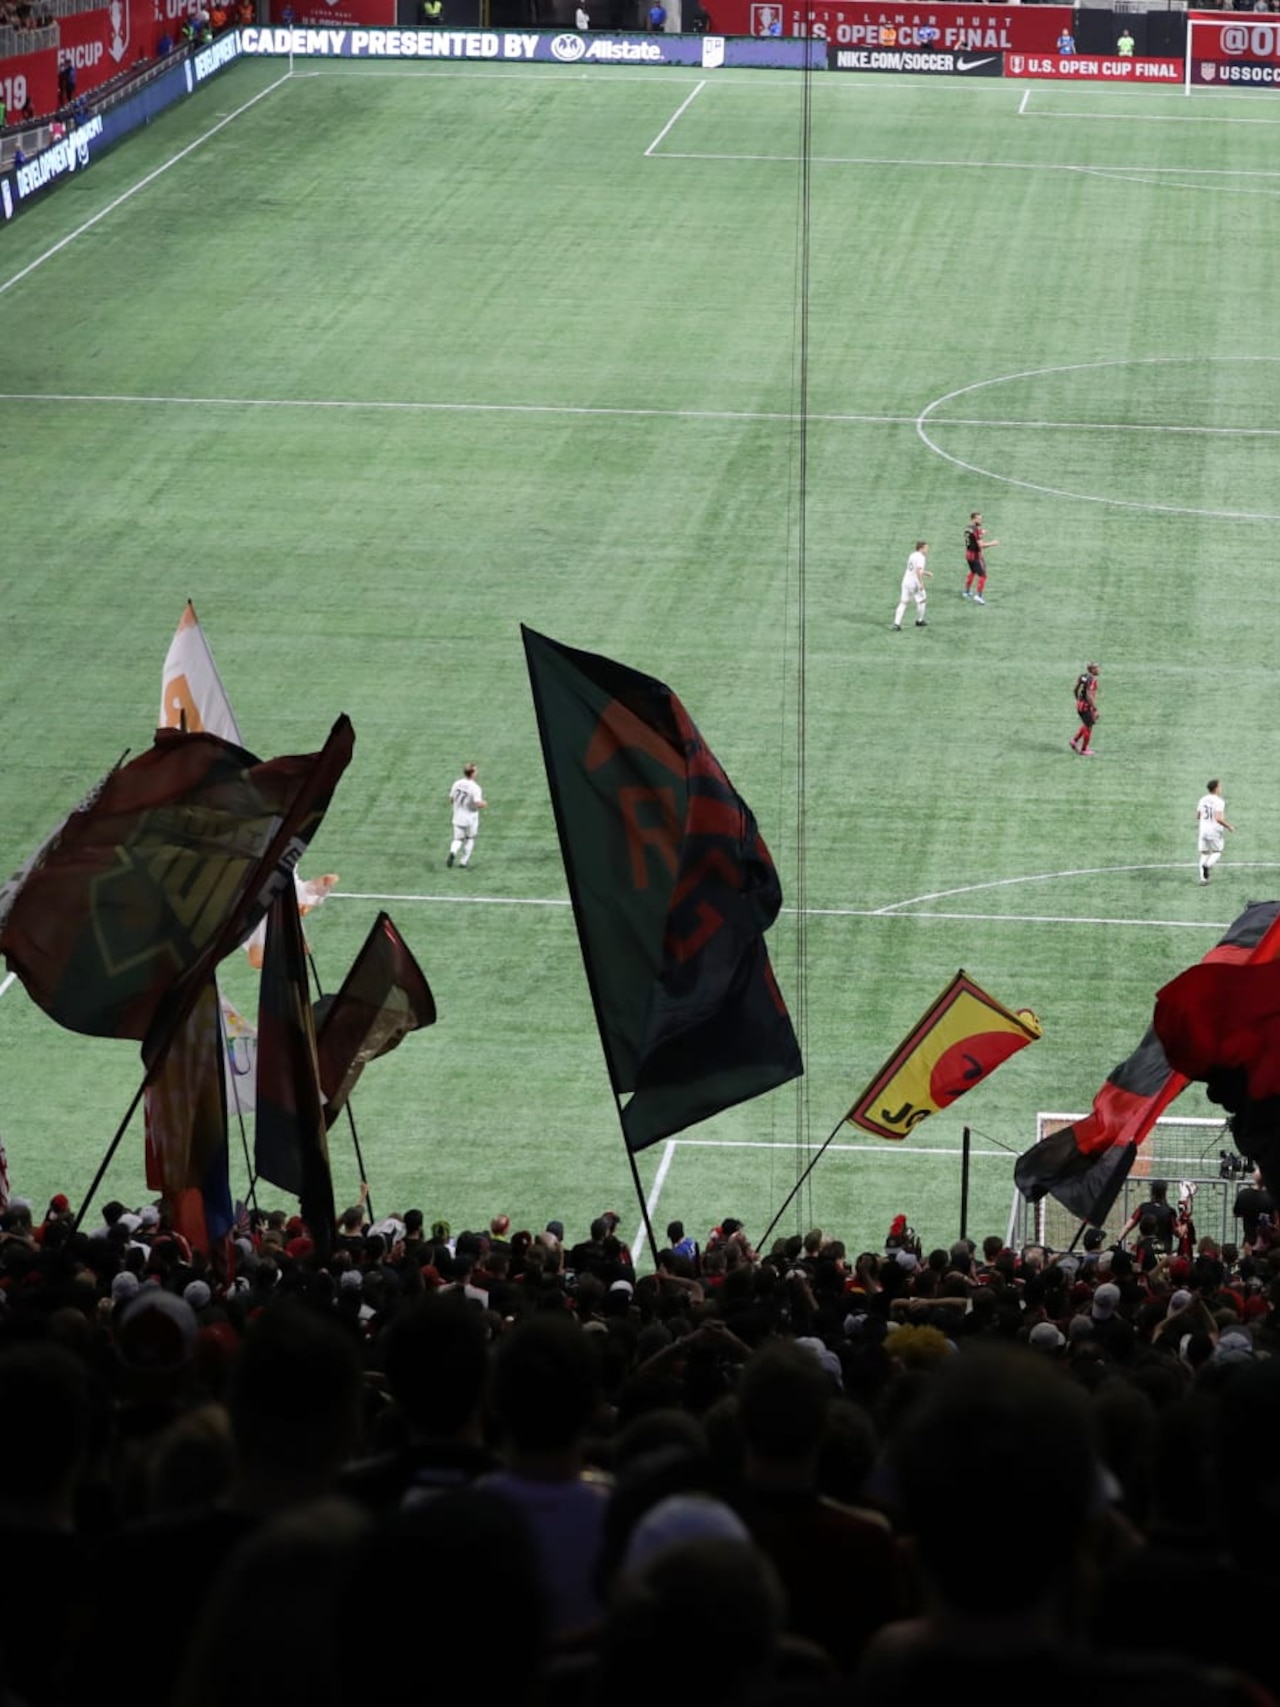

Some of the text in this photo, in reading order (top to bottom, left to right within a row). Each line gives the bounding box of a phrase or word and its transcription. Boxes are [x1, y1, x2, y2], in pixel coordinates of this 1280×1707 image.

[864, 14, 936, 25] LAMAR
[957, 17, 1012, 27] HUNT
[352, 31, 499, 58] PRESENTED
[504, 35, 539, 58] BY
[945, 28, 1012, 48] FINAL
[837, 51, 954, 71] NIKE.COM/SOCCER
[1028, 58, 1178, 78] U.S. OPEN CUP FINAL
[1203, 804, 1213, 820] 31
